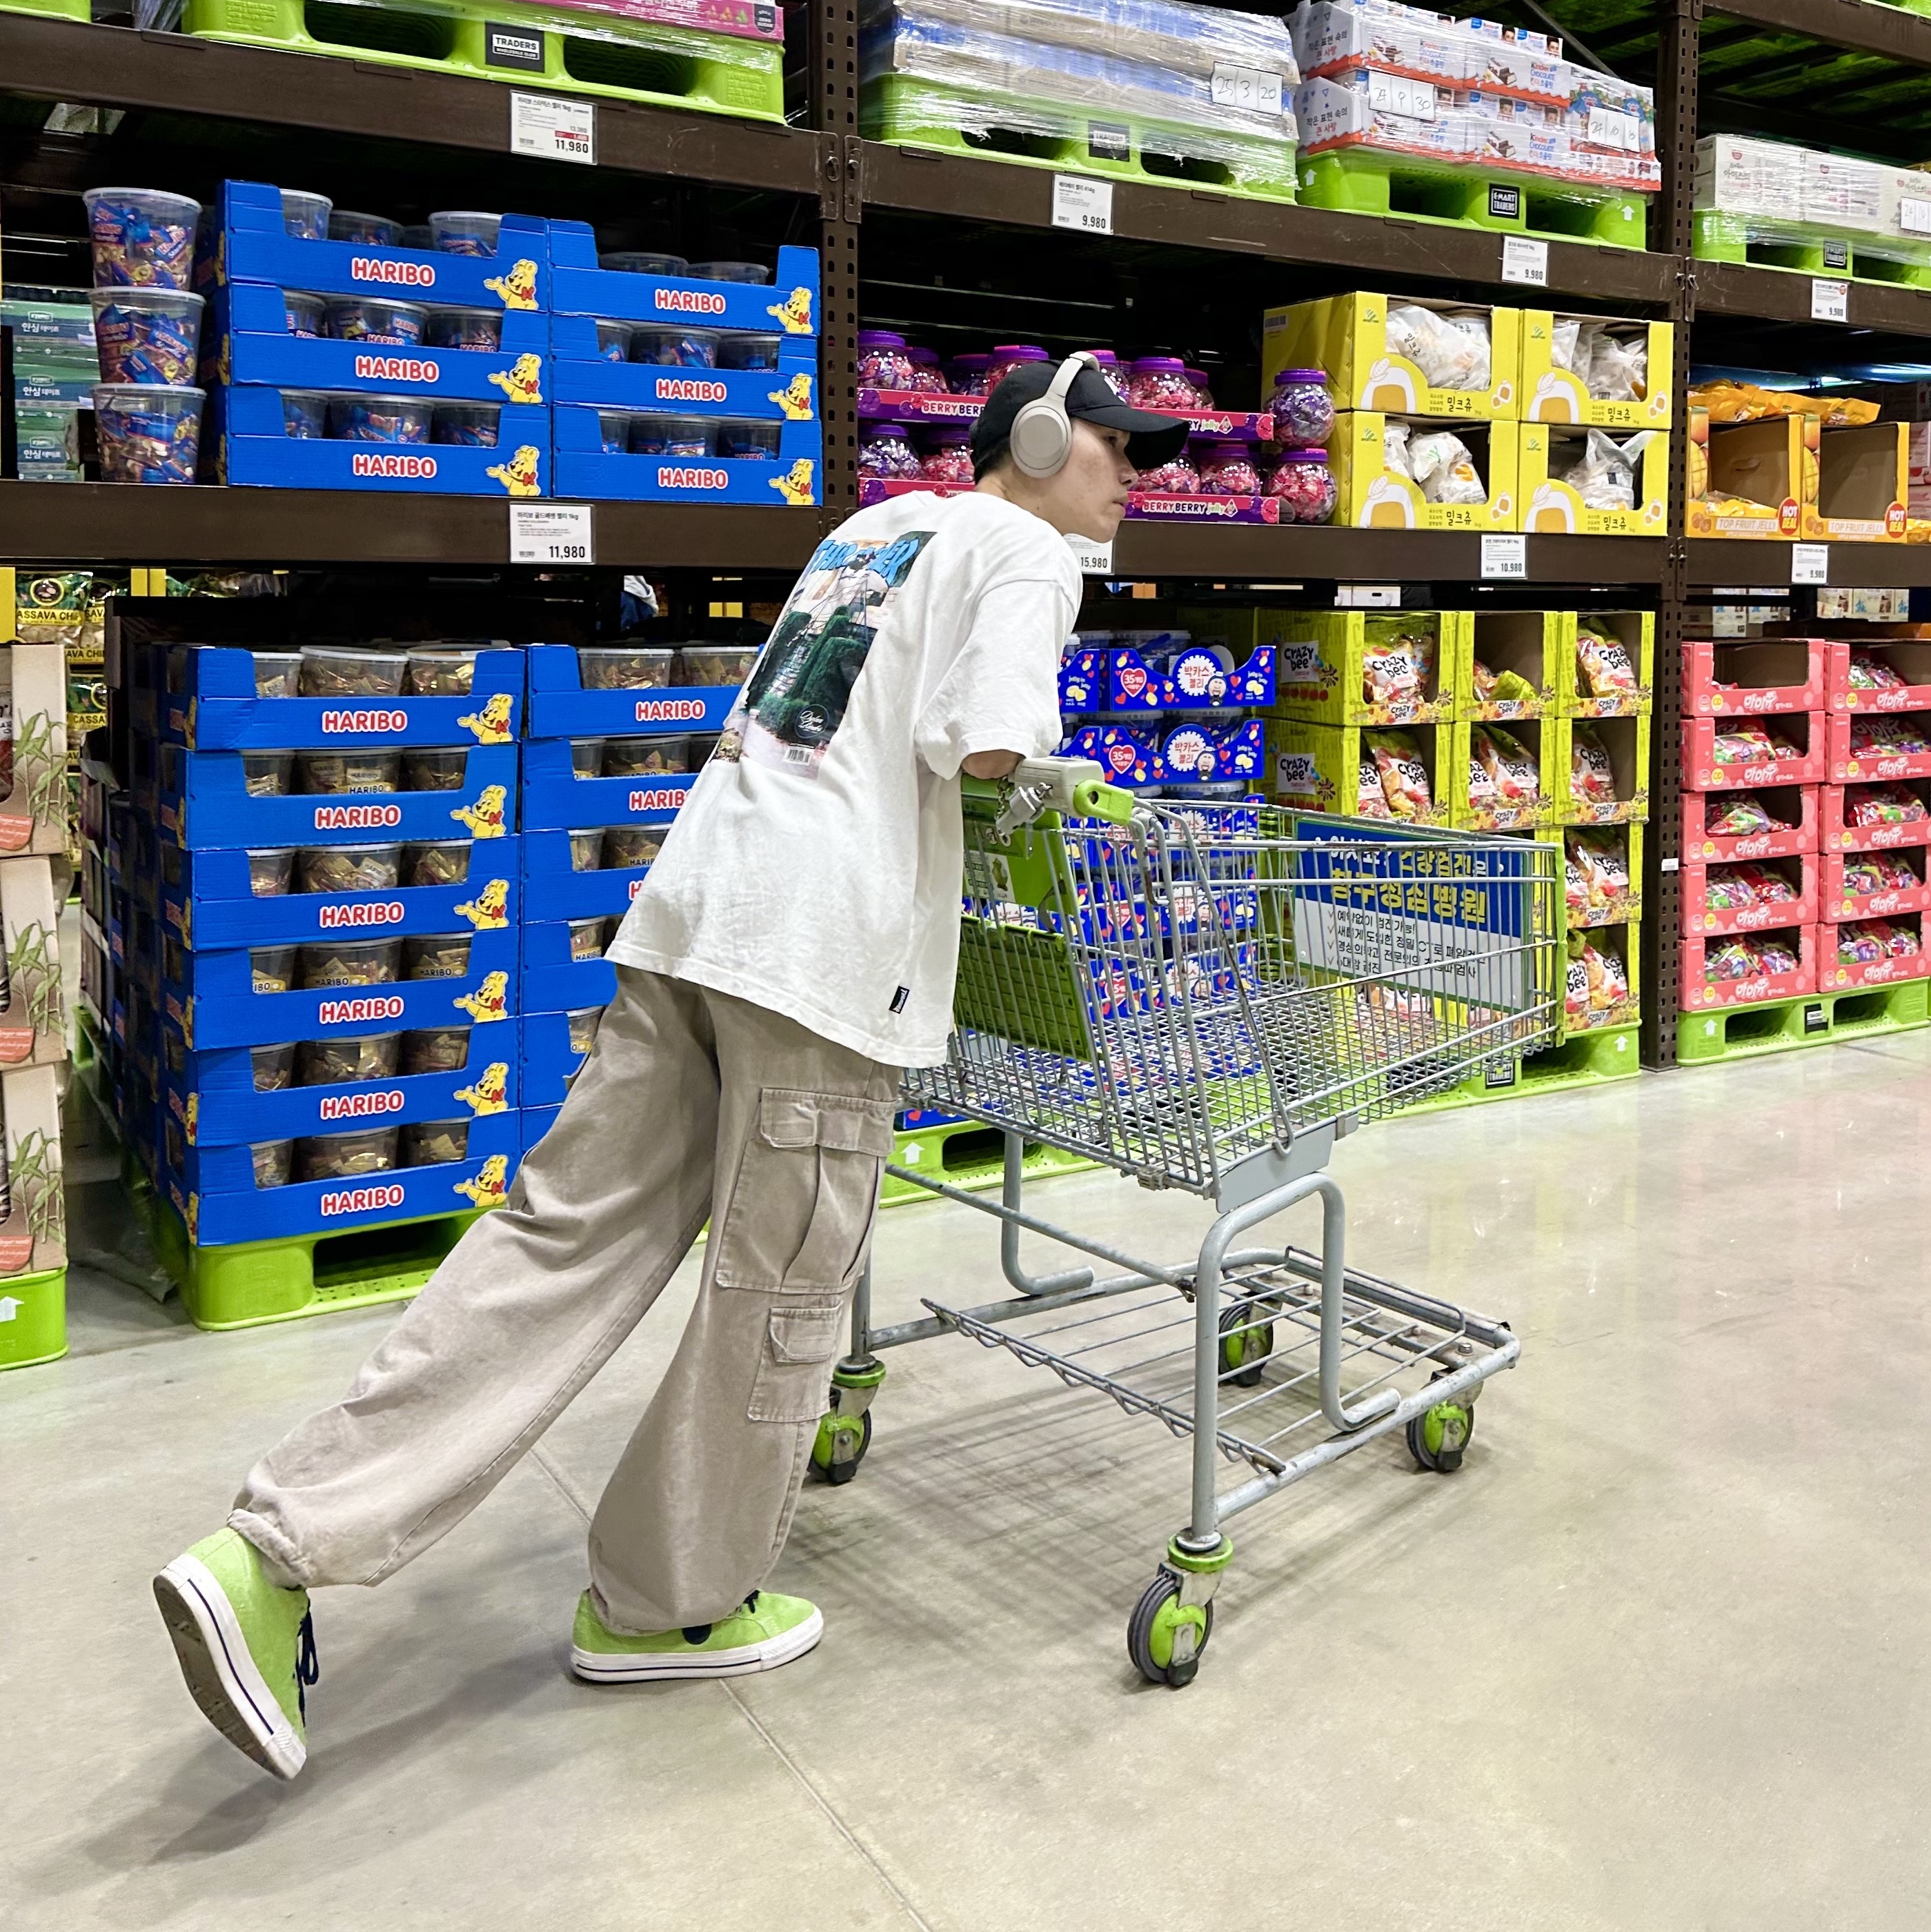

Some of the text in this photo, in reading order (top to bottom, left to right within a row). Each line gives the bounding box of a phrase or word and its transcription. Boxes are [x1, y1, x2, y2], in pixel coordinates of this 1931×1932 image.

[495, 37, 537, 50] TRADERS
[1320, 35, 1333, 46] 표현
[1334, 30, 1348, 42] 속의
[1215, 76, 1277, 100] 25 3 20
[1398, 92, 1407, 108] 9
[1416, 97, 1432, 112] 30
[1320, 111, 1333, 123] 표현
[1334, 106, 1348, 119] 속의
[1316, 126, 1323, 136] 큰
[555, 139, 588, 154] 11,980
[1082, 215, 1107, 229] 9,980
[353, 259, 435, 286] HARIBO
[656, 289, 725, 313] HARIBO
[356, 356, 439, 381] HARIBO
[657, 379, 726, 401] HARIBO
[1447, 396, 1472, 412] 밀크츄
[1607, 408, 1631, 422] 밀크츄
[353, 455, 436, 477] HARIBO
[658, 468, 727, 488] HARIBO
[1142, 500, 1206, 513] BERRYBERRY
[1781, 506, 1799, 517] HOT
[1447, 510, 1472, 526] 밀크츄
[1889, 510, 1905, 521] HOT
[1603, 517, 1627, 531] 밀크츄
[1719, 519, 1778, 531] TOP FRUIT JELLY
[1863, 522, 1885, 533] JELLY
[548, 546, 586, 560] 11,980
[1080, 556, 1108, 569] 15,980
[1501, 562, 1523, 573] 10,980
[17, 610, 57, 620] ASSAVA
[1184, 665, 1210, 677] 박카스
[1290, 659, 1309, 671] bee
[1189, 678, 1205, 688] 젤리
[635, 699, 705, 721] HARIBO
[73, 715, 105, 724] CASSA
[322, 711, 407, 733] HARIBO
[1174, 742, 1200, 753] 박카스
[1178, 754, 1194, 764] 젤리
[1589, 758, 1607, 770] bee
[1285, 768, 1306, 782] bee
[1360, 776, 1378, 786] ee
[1407, 770, 1427, 785] bee
[349, 784, 384, 794] HARIBO
[629, 790, 690, 810] HARIB
[315, 805, 401, 828] HARIBO
[630, 857, 656, 866] HARIB
[320, 902, 404, 928] HARIBO
[1396, 936, 1415, 950] 정밀
[254, 983, 270, 992] IBO
[320, 996, 403, 1023] HARIBO
[321, 1091, 404, 1119] HARIBO
[321, 1184, 404, 1215] HARIBO
